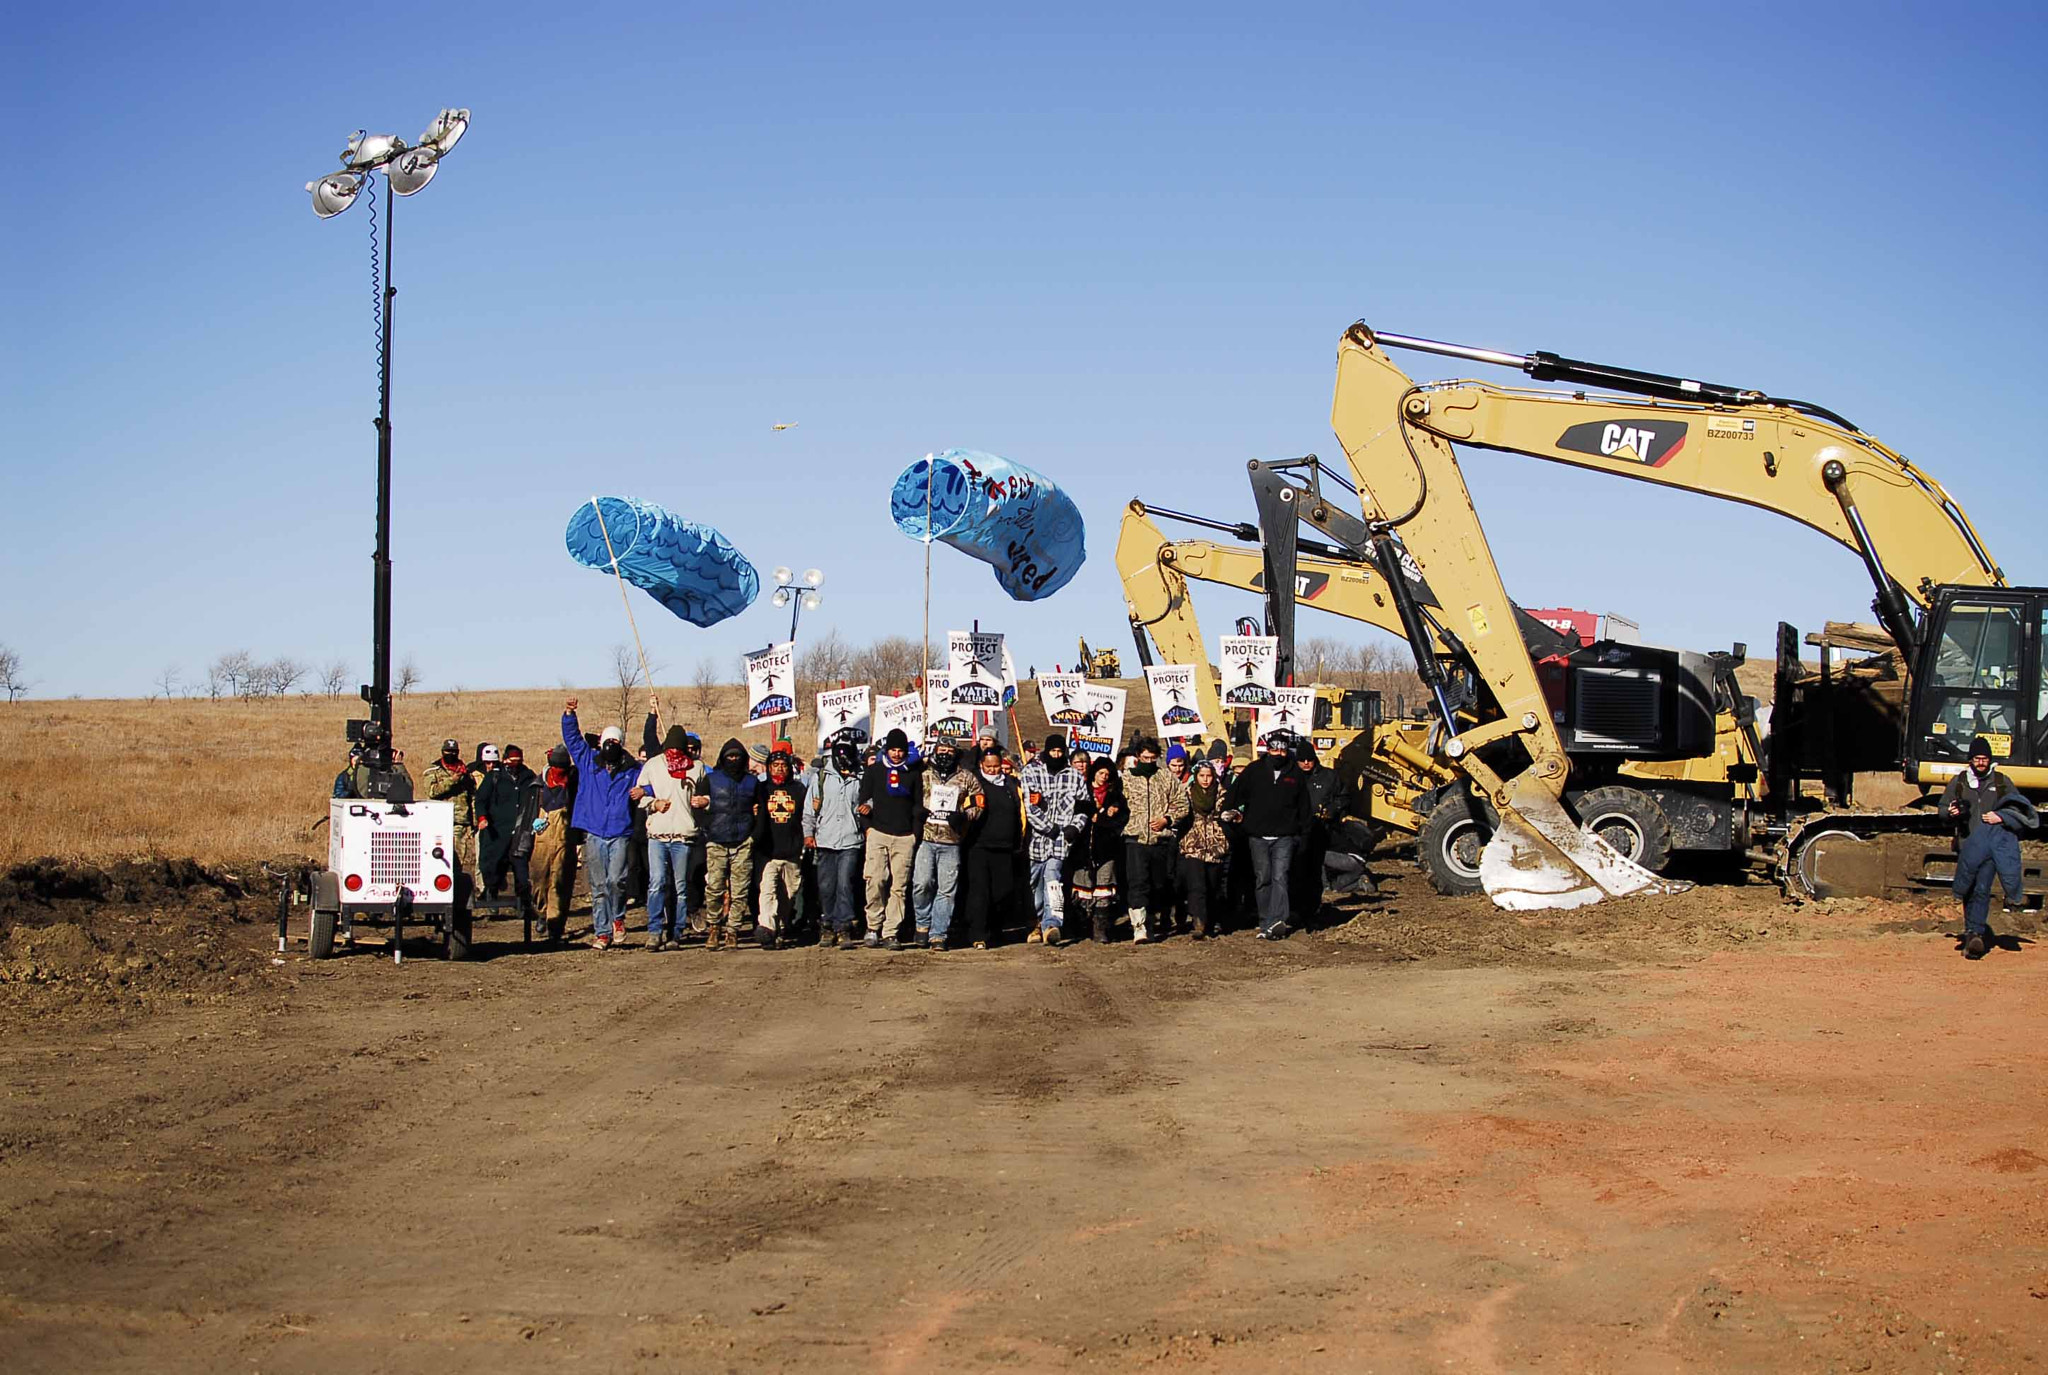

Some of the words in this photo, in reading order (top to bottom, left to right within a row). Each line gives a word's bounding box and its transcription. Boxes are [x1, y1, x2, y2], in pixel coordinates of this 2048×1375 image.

[1707, 429, 1754, 440] BZ200733
[1600, 423, 1655, 462] CAT
[951, 642, 998, 654] PROTECT
[1225, 645, 1272, 656] PROTECT
[750, 653, 791, 673] PROTECT
[1042, 680, 1081, 688] PROTECT
[1153, 674, 1189, 685] PROTECT
[958, 686, 995, 698] WATER
[1232, 686, 1271, 699] WATER
[757, 697, 790, 713] WATER
[822, 692, 864, 708] PROTECT
[1277, 694, 1310, 705] OTECT
[883, 700, 918, 718] PROTECT
[936, 720, 973, 731] WATER
[1070, 740, 1111, 753] GROUND
[1317, 738, 1332, 747] CAT
